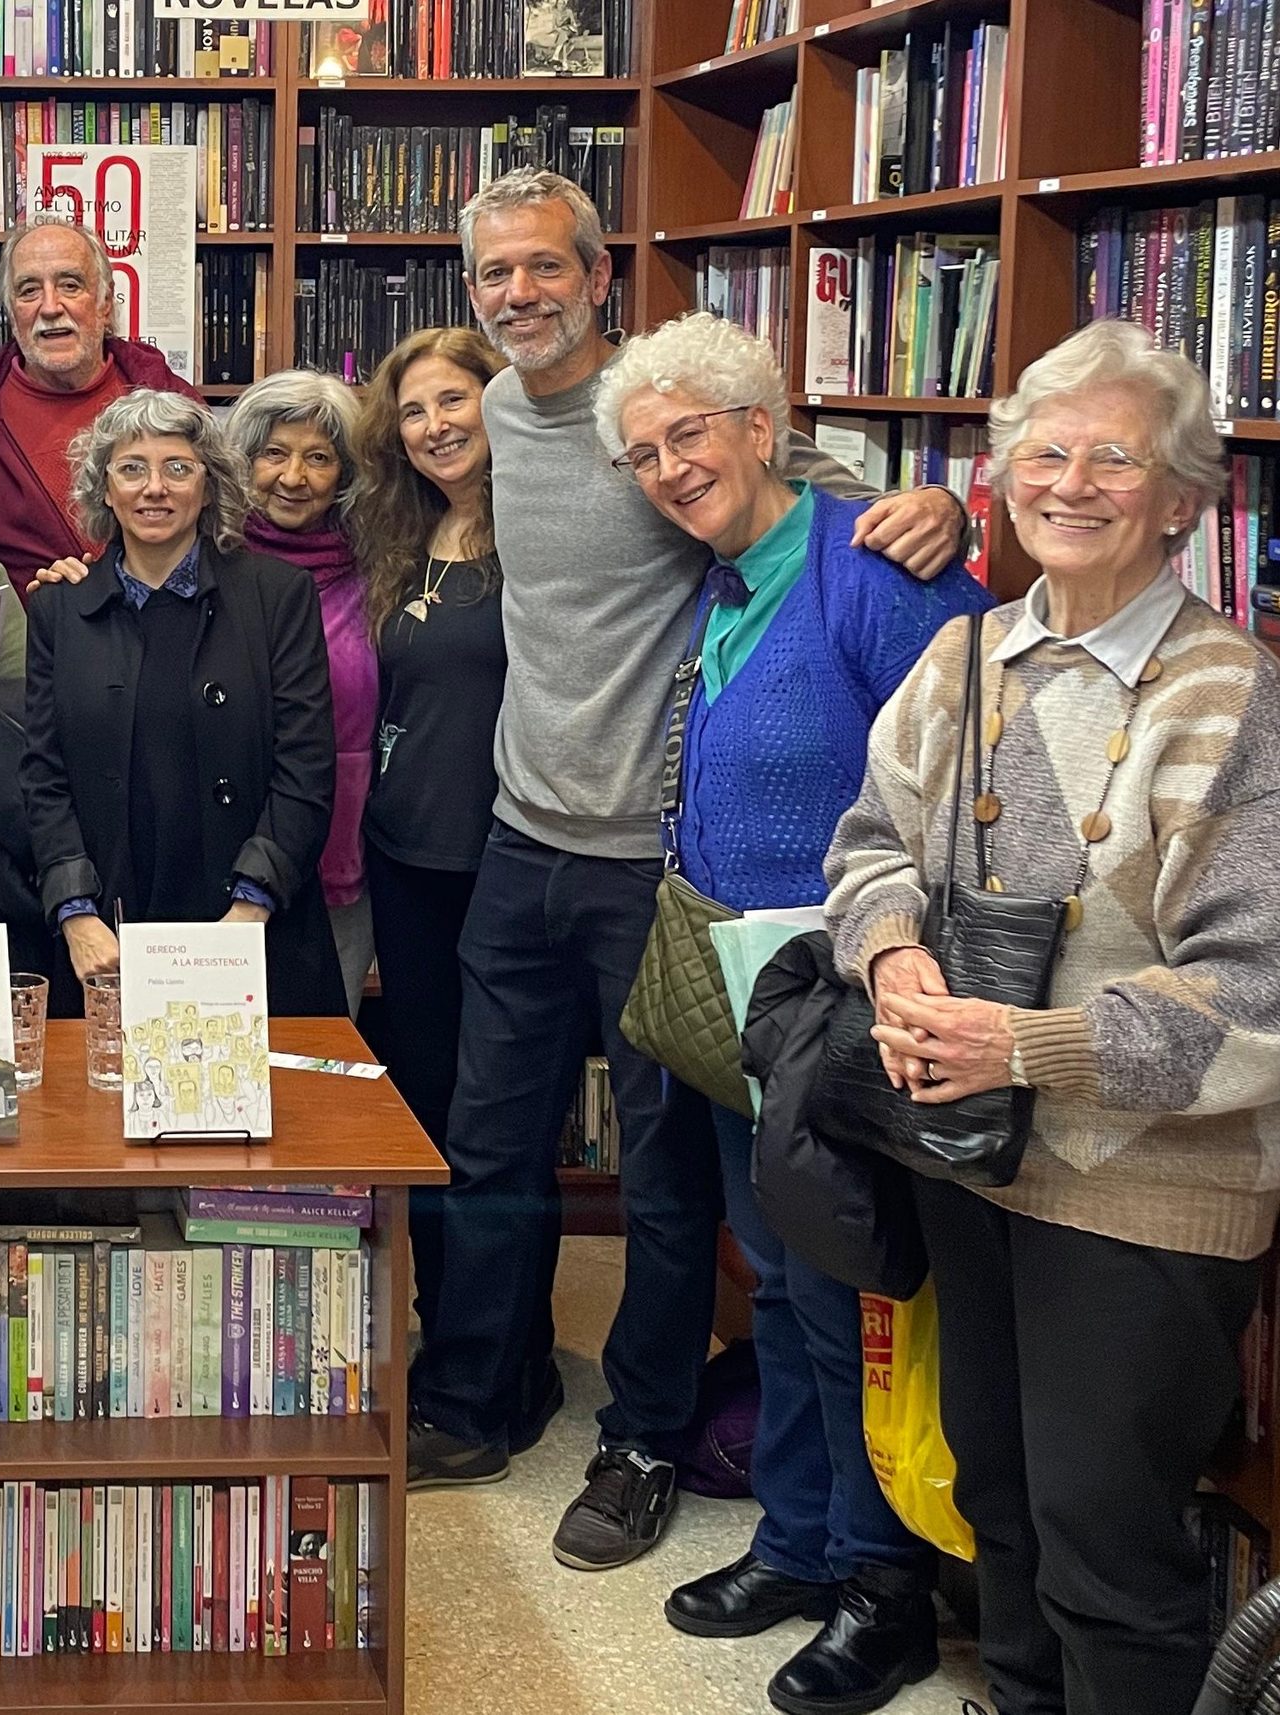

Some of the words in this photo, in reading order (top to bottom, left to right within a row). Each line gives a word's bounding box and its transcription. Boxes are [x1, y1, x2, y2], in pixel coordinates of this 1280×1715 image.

[34, 200, 62, 213] DEL
[146, 945, 187, 954] DERECHO
[171, 958, 179, 967] A
[180, 958, 191, 967] LA
[194, 958, 249, 967] RESISTENCIA
[301, 1207, 324, 1215] ALICE
[58, 1260, 71, 1269] TI
[154, 1262, 164, 1292] HATE
[230, 1250, 244, 1294] STRIKER
[132, 1266, 142, 1298] LOVE
[176, 1260, 186, 1301] GAMES
[203, 1274, 212, 1300] LIES
[58, 1287, 71, 1318] PESAR
[230, 1296, 244, 1320] THE
[78, 1328, 88, 1358] HOOVER
[78, 1360, 88, 1394] COLLEEN
[293, 1567, 323, 1575] PANCHO
